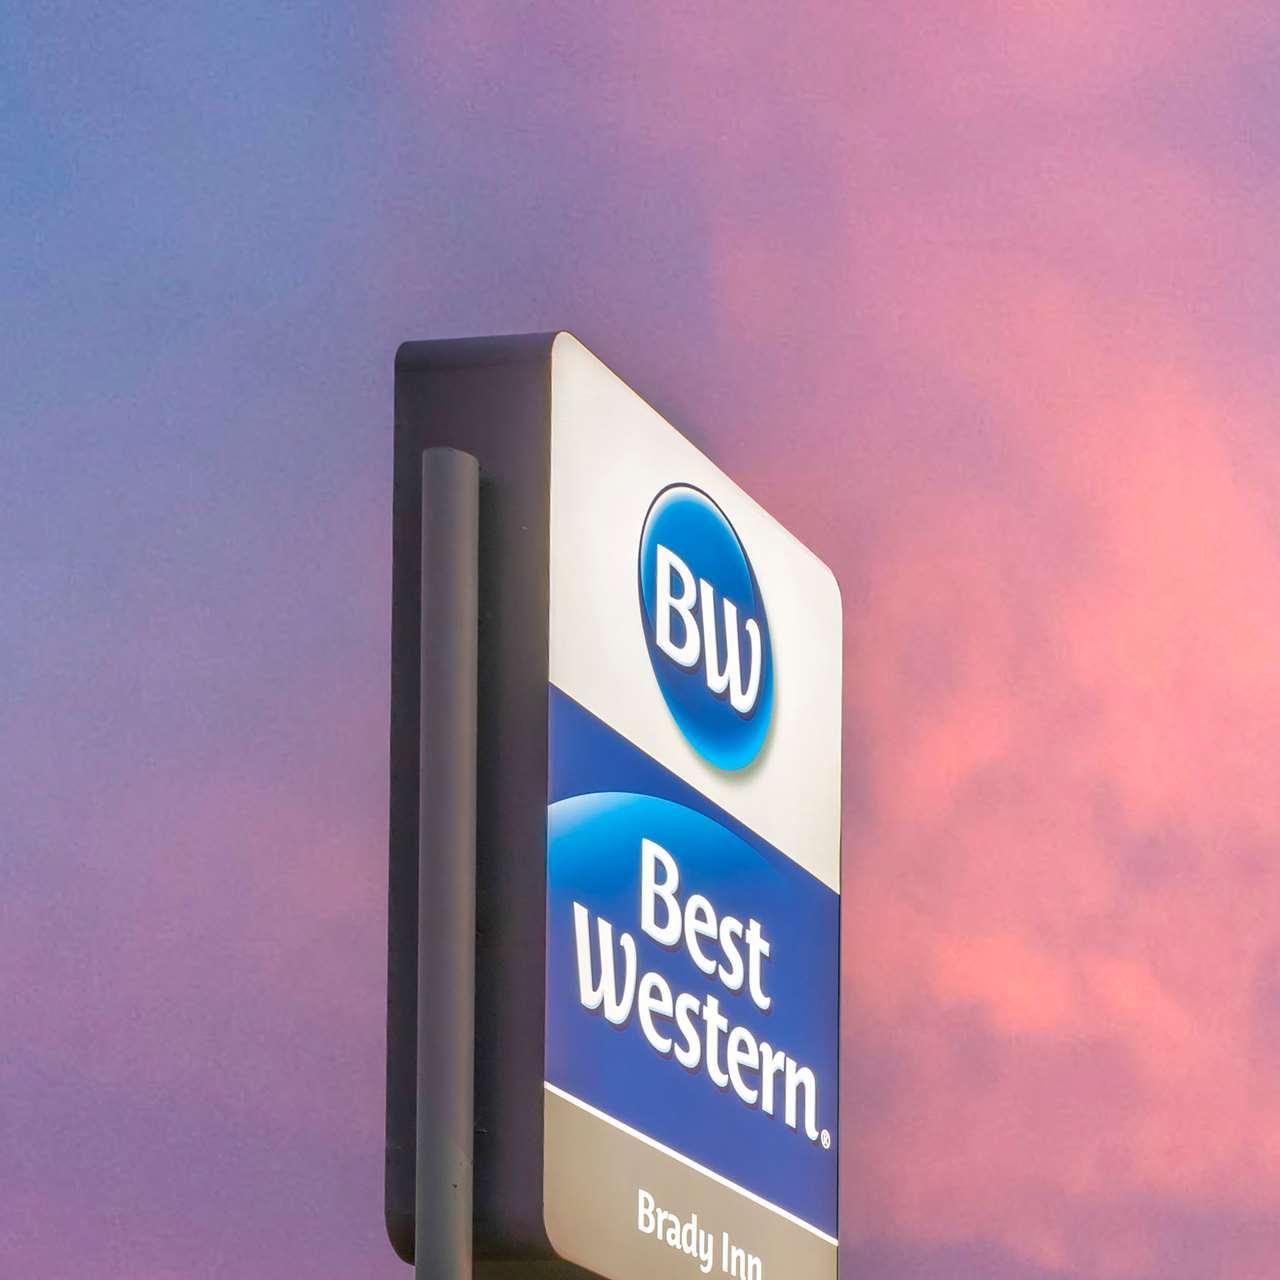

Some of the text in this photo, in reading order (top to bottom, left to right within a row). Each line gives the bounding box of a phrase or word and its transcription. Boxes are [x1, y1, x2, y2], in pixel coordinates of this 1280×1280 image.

[656, 544, 762, 715] BW
[641, 838, 771, 1010] Best
[638, 1188, 713, 1274] Brady
